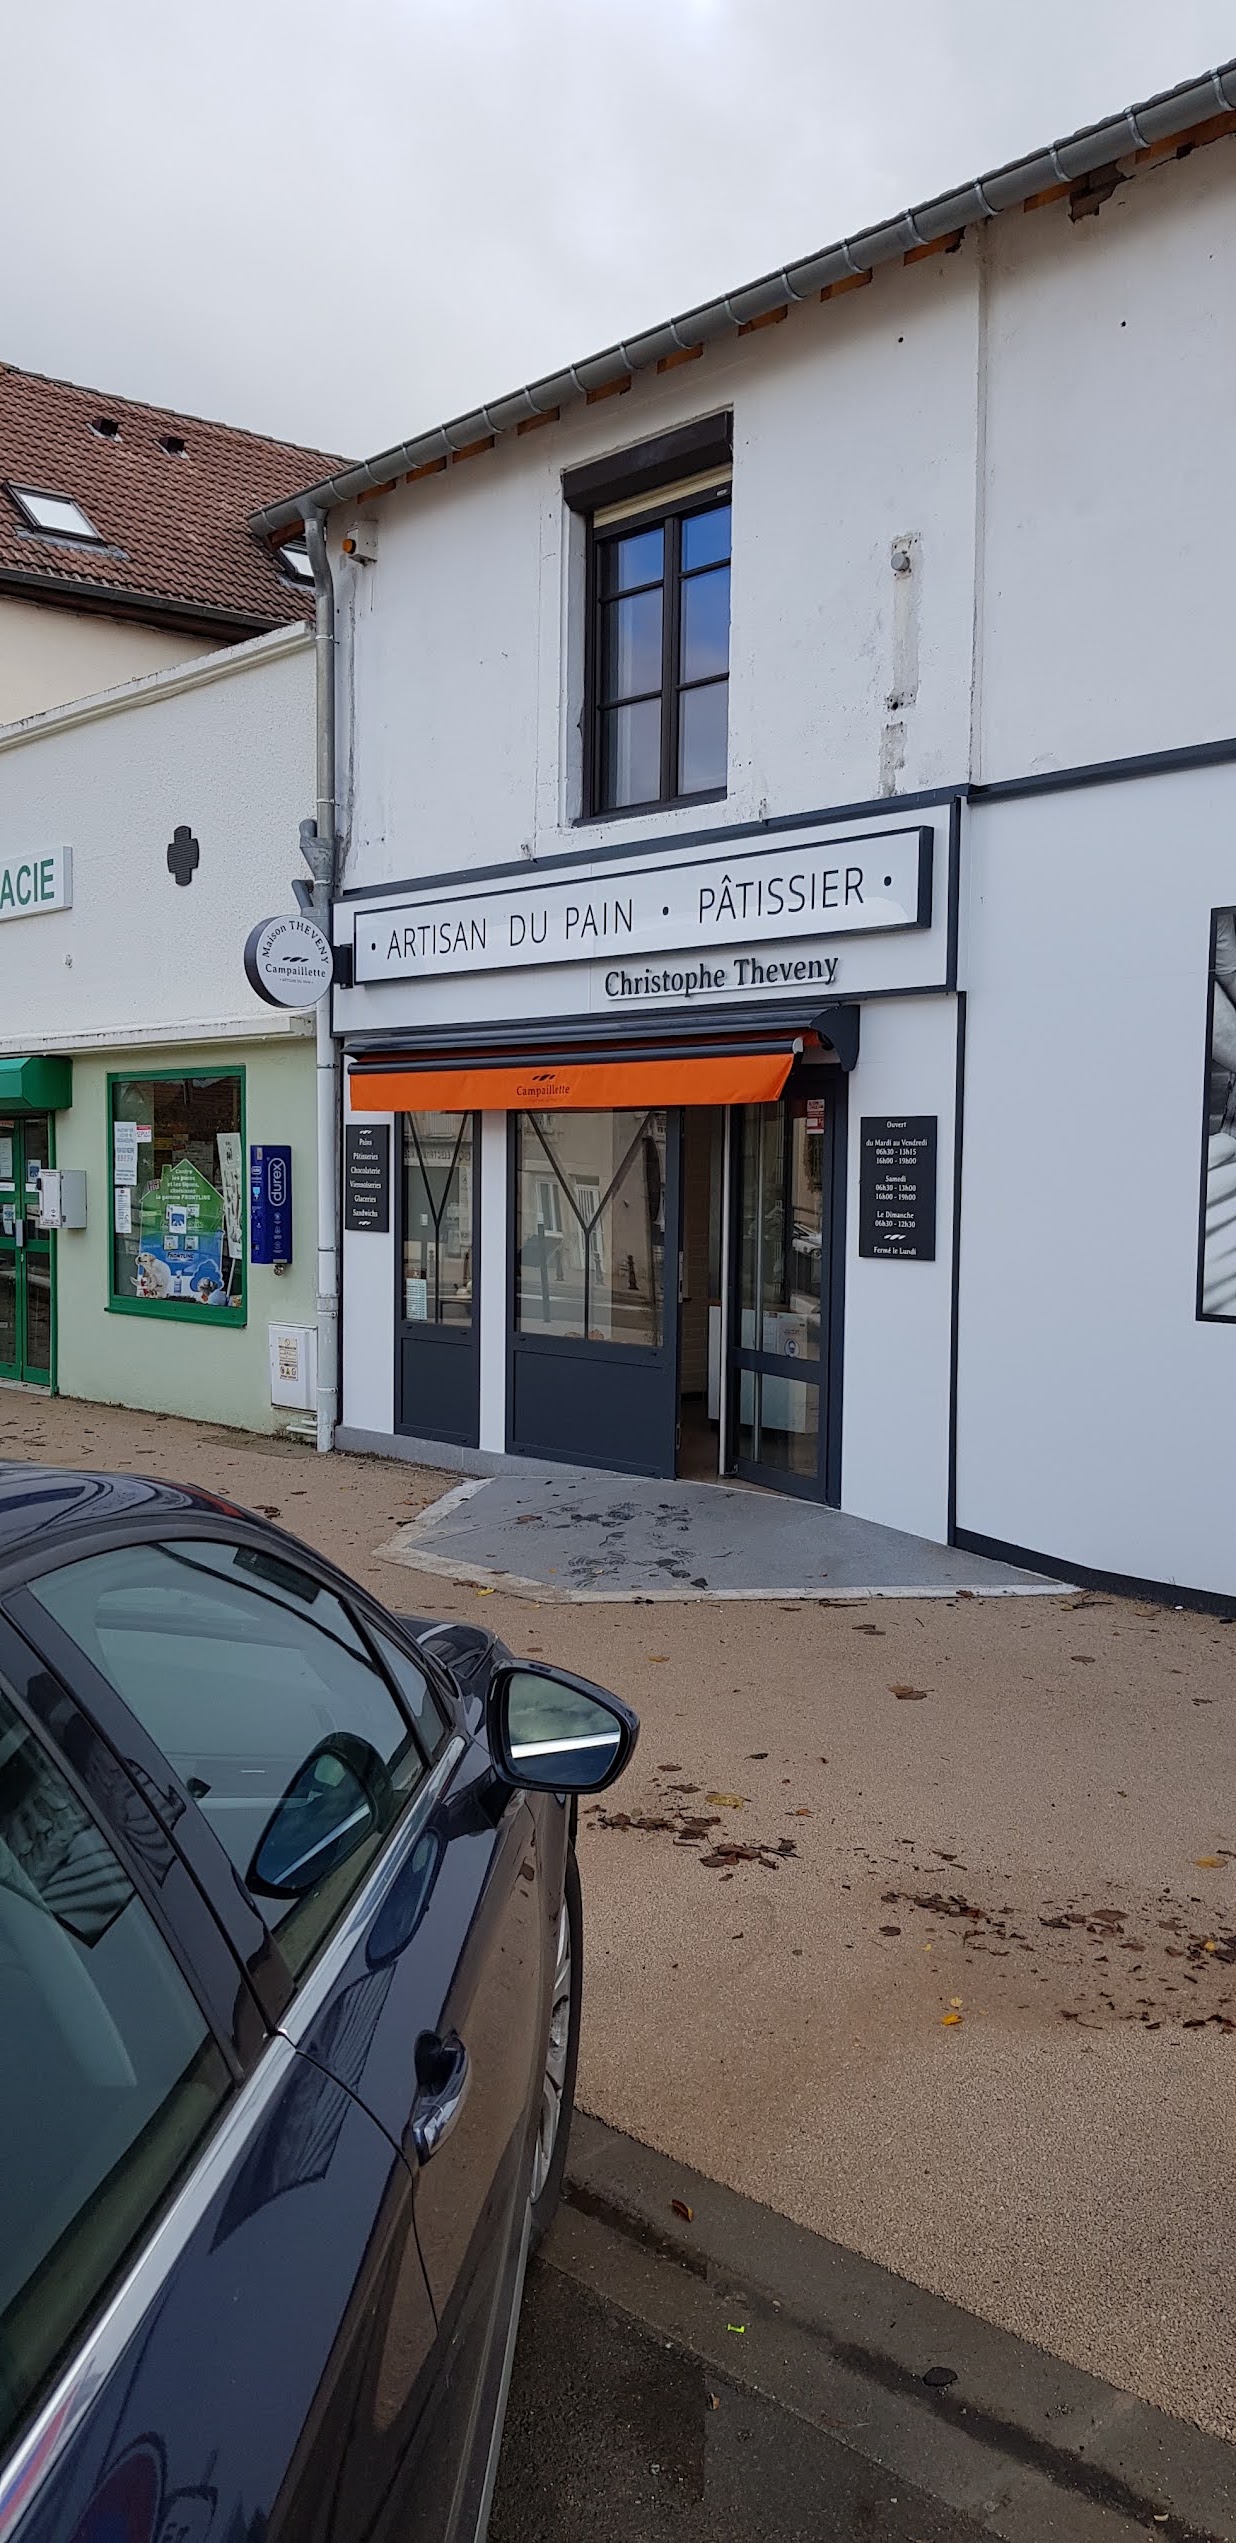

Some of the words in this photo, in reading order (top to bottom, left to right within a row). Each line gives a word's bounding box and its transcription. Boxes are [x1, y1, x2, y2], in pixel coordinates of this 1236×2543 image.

[387, 918, 487, 960] ARTISAN
[509, 910, 548, 947] DU
[566, 899, 633, 940] PAIN
[699, 867, 865, 924] PÂTISSIER
[262, 925, 287, 958] Maison
[288, 920, 329, 964] THEVENY
[265, 963, 326, 978] Campaillette
[604, 964, 726, 998] Christophe
[734, 957, 839, 986] Theveny
[516, 1084, 571, 1098] Campaillette
[874, 1138, 892, 1147] Mardi
[901, 1138, 928, 1147] Vendredi
[875, 1148, 894, 1156] 06h30
[899, 1148, 917, 1156] 13h15
[876, 1157, 894, 1165] 16h00
[898, 1157, 917, 1165] 19h00
[271, 1162, 284, 1201] durex
[885, 1175, 907, 1183] Samedi
[898, 1184, 917, 1192] 13h00
[898, 1193, 916, 1201] 19h00
[877, 1210, 885, 1218] Le
[885, 1210, 914, 1219] Dimanche
[874, 1219, 893, 1227] 06h30
[898, 1220, 916, 1228] 12h30
[873, 1246, 892, 1254] Fermé
[893, 1247, 899, 1255] le
[899, 1247, 917, 1256] Lundi
